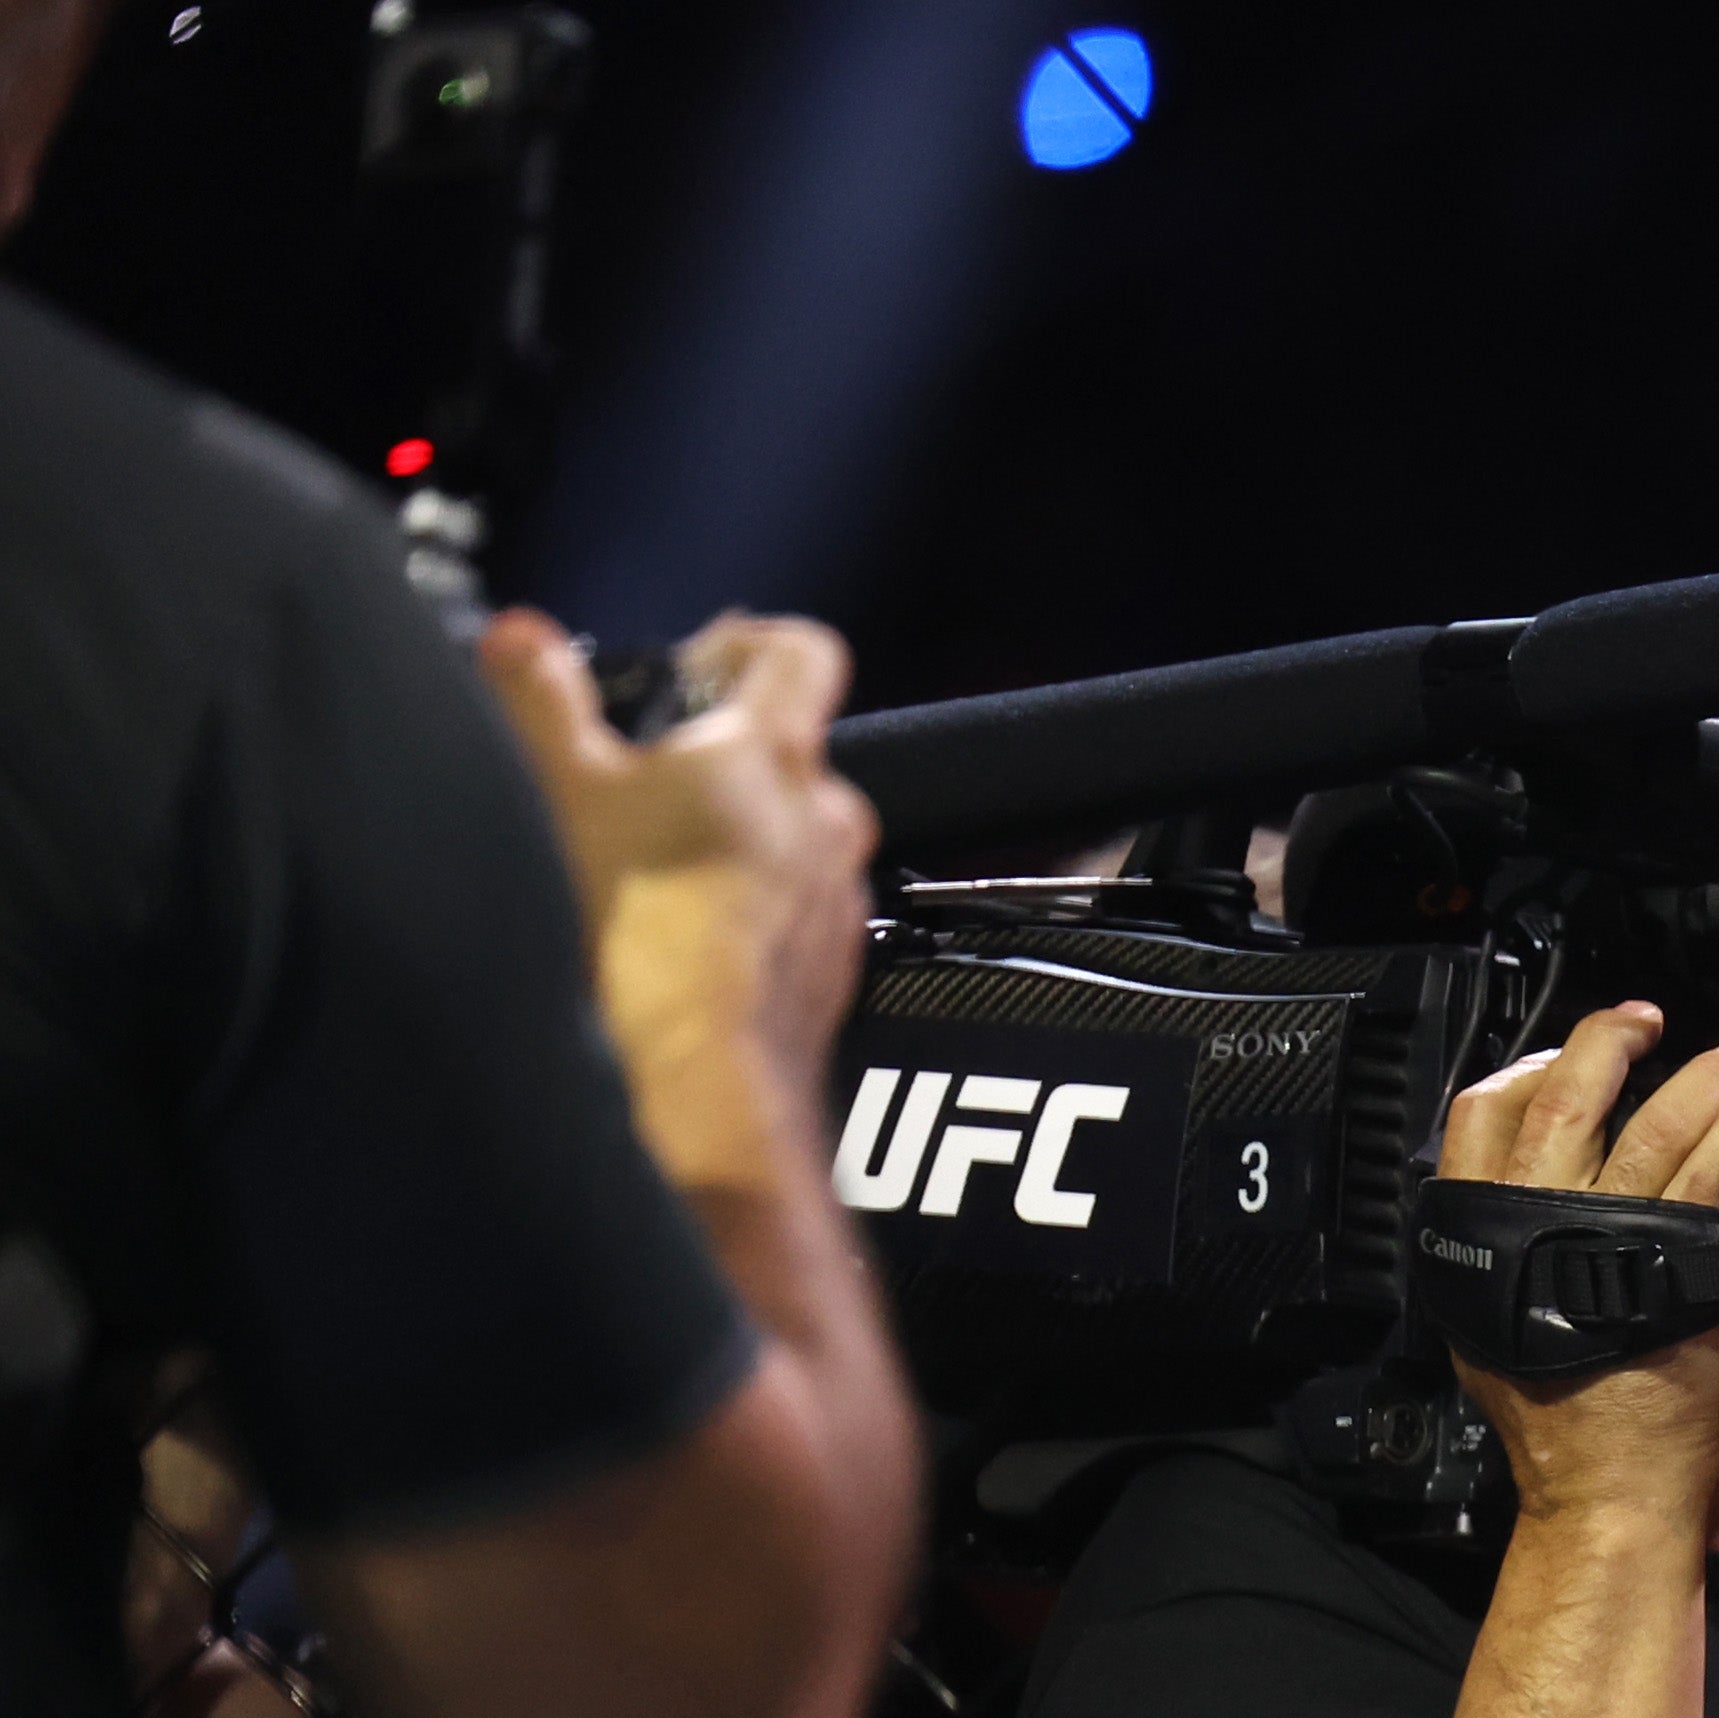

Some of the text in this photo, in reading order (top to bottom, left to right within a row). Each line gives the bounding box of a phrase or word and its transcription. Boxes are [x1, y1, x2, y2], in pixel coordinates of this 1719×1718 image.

[1210, 1028, 1321, 1060] SONY
[832, 1067, 1130, 1229] UFC
[1237, 1141, 1270, 1214] 3
[1420, 1227, 1493, 1272] Canon
